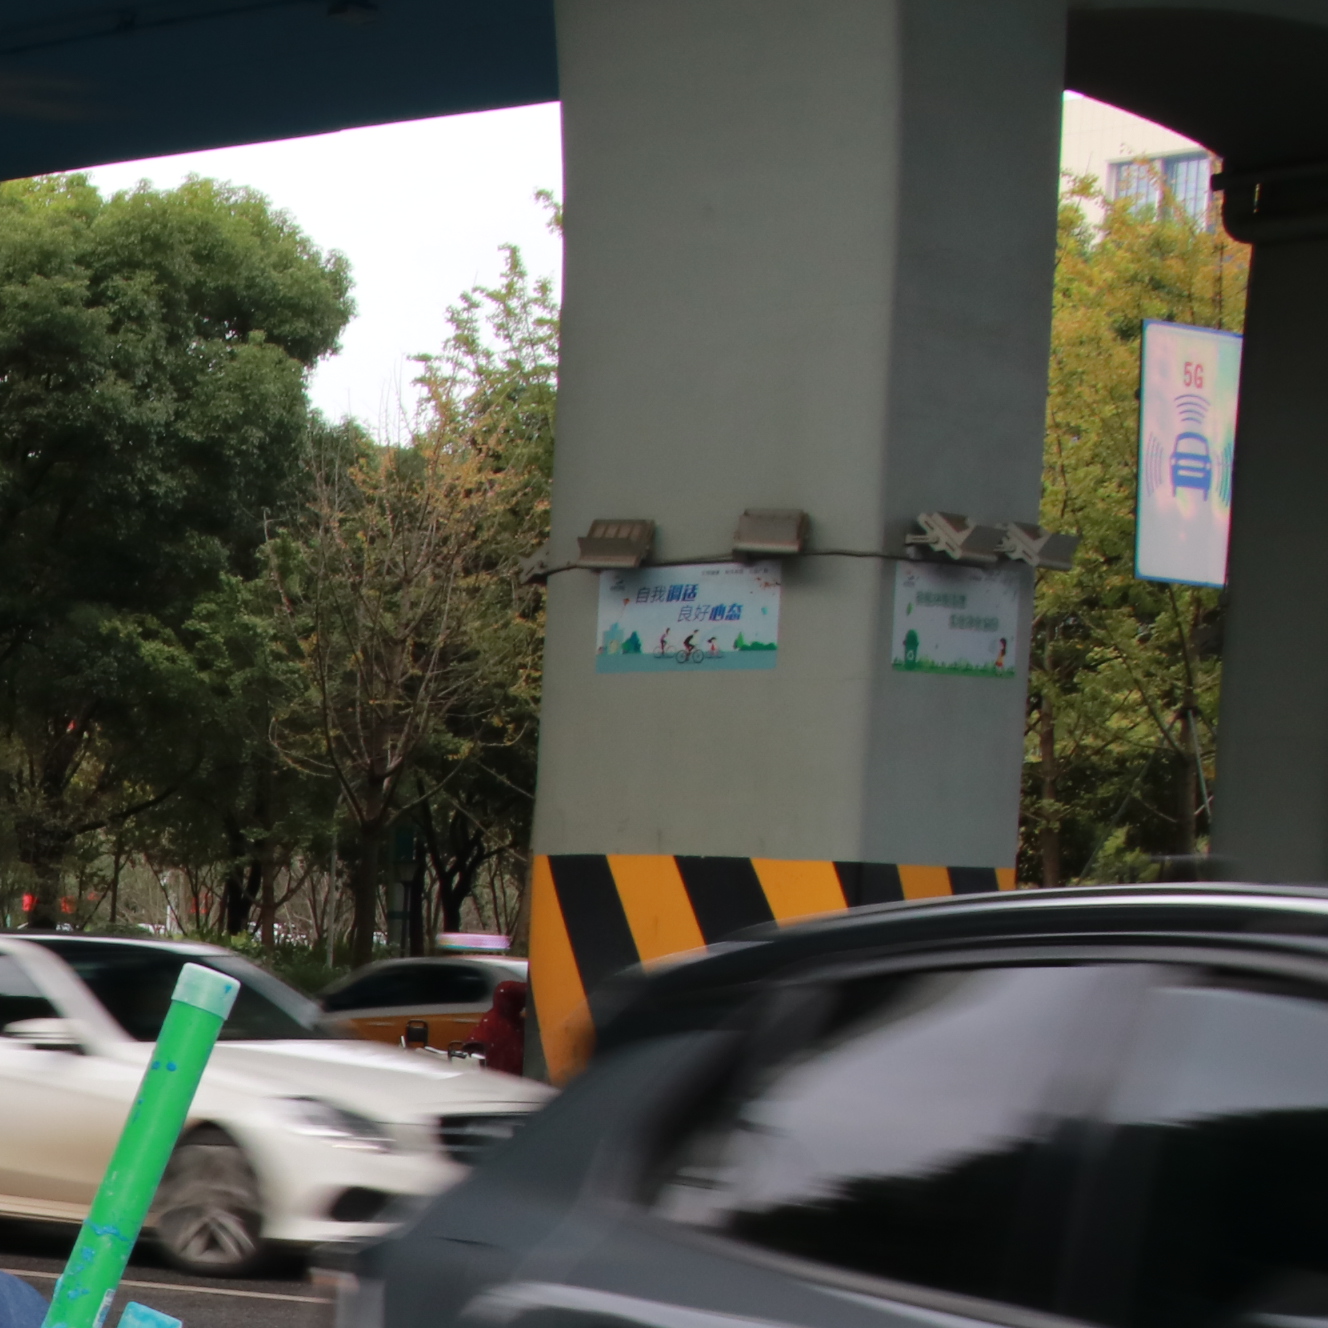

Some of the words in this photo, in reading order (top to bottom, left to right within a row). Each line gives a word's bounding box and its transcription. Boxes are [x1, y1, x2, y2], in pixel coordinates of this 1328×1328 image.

[1182, 361, 1204, 389] 5G
[635, 583, 700, 605] 自我调适
[677, 602, 744, 623] 良好心态
